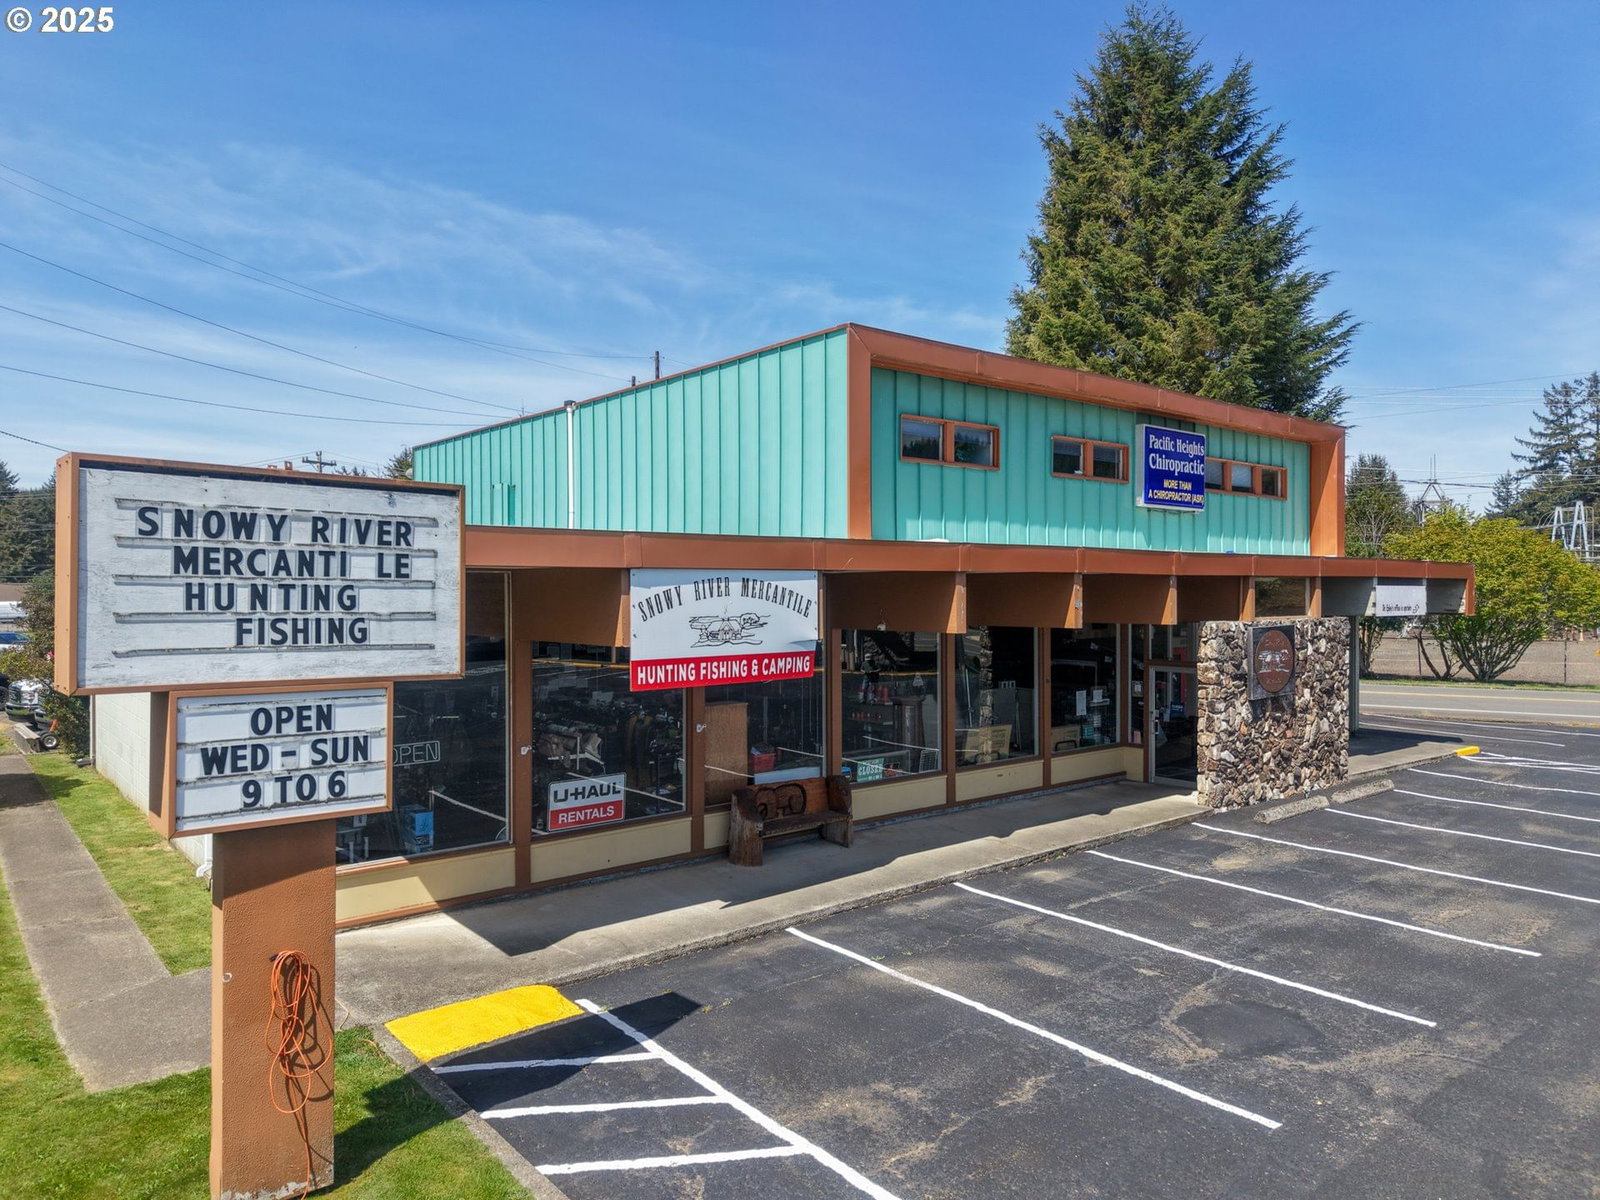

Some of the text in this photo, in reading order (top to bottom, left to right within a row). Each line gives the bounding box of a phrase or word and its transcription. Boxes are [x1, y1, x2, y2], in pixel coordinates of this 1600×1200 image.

[1149, 434, 1204, 458] Pacific Heights
[1149, 453, 1204, 476] Chiropractic
[1148, 489, 1153, 499] A
[1153, 489, 1191, 502] CHIROPRACTOR
[1163, 479, 1192, 491] MORE THAN
[138, 506, 412, 547] SNOWY RIVER
[173, 546, 411, 579] MERCANTILE
[185, 582, 357, 612] HUNTING
[638, 577, 812, 622] SNOWY RIVER MERCANTILE
[236, 617, 368, 646] FISHING
[637, 656, 810, 685] HUNTING FISHING & CAMPING
[250, 704, 332, 736] OPEN
[242, 771, 346, 808] 9 TO 6
[553, 782, 621, 803] U-HAUL
[558, 805, 615, 824] RENTALS
